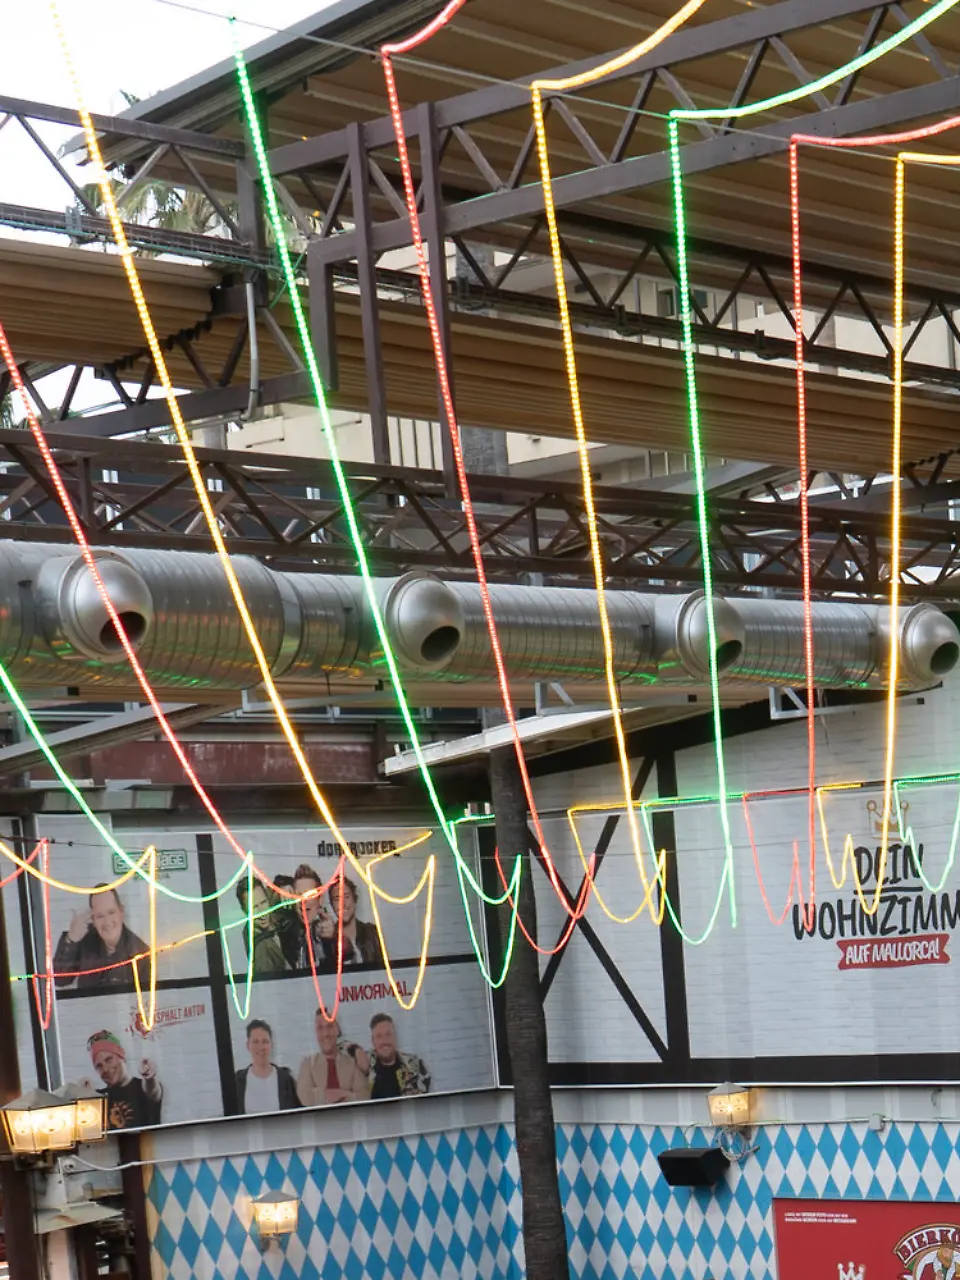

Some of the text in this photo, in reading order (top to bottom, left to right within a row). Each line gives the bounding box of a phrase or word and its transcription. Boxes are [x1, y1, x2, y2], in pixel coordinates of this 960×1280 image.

[853, 842, 924, 886] DEIN
[845, 938, 940, 965] AUF MALLORCA!
